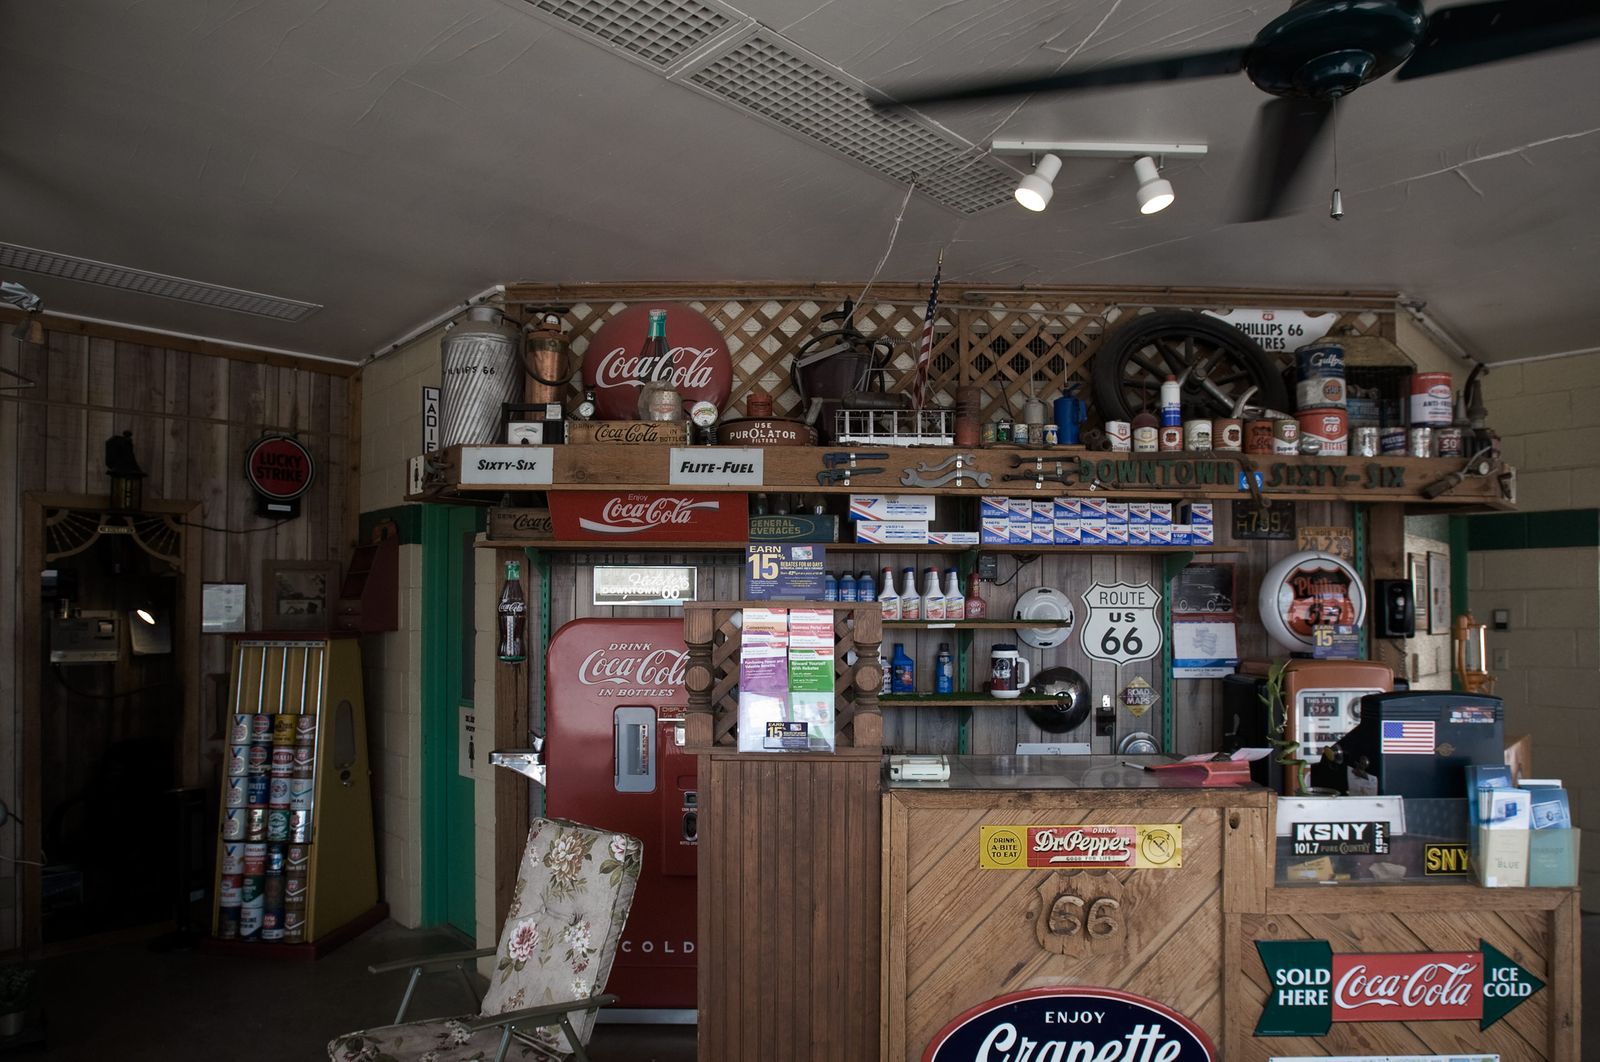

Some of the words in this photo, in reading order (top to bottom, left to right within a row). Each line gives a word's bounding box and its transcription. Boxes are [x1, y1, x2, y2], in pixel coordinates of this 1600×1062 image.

[1235, 323, 1284, 336] PHILLIPS
[1288, 324, 1304, 336] 66
[482, 366, 495, 375] 66
[596, 346, 719, 388] Coca-Cola
[594, 422, 660, 442] Coca-Cola
[730, 427, 796, 440] PUROLATOR
[259, 452, 303, 469] LUCKY
[477, 459, 537, 471] SIXTY-SIX
[680, 461, 754, 473] FLITE-FUEL
[256, 466, 303, 483] STRIKE
[1079, 459, 1235, 486] DOWNTOWN
[628, 494, 648, 502] Enjoy
[602, 497, 694, 524] Coca-Cola
[513, 513, 553, 532] Coca-C
[751, 520, 795, 528] GENERAL
[750, 527, 800, 535] EVERAGES
[749, 545, 782, 553] EARN
[602, 586, 659, 594] DOWNTOWN
[662, 586, 680, 600] 66
[1100, 592, 1145, 606] ROUTE
[498, 602, 526, 614] Coca-Cola
[1109, 612, 1136, 622] US
[608, 642, 652, 651] DRINK
[1101, 627, 1143, 655] 66
[578, 649, 691, 686] Coca-Col
[599, 688, 616, 697] IN
[616, 688, 675, 697] BOTTLES
[1128, 688, 1150, 696] ROAD
[1127, 697, 1150, 705] MAPS
[1296, 824, 1368, 841] KSNY
[1375, 822, 1384, 853] KSNY
[1294, 842, 1320, 854] 101.7
[1048, 895, 1120, 939] 66
[621, 940, 695, 954] COLD
[1276, 968, 1331, 986] SOLD
[1492, 967, 1518, 982] ICE
[1334, 961, 1480, 1010] Coca-Cola
[1483, 982, 1532, 998] COLD
[1278, 989, 1328, 1006] HERE
[1044, 1011, 1106, 1024] ENJOY
